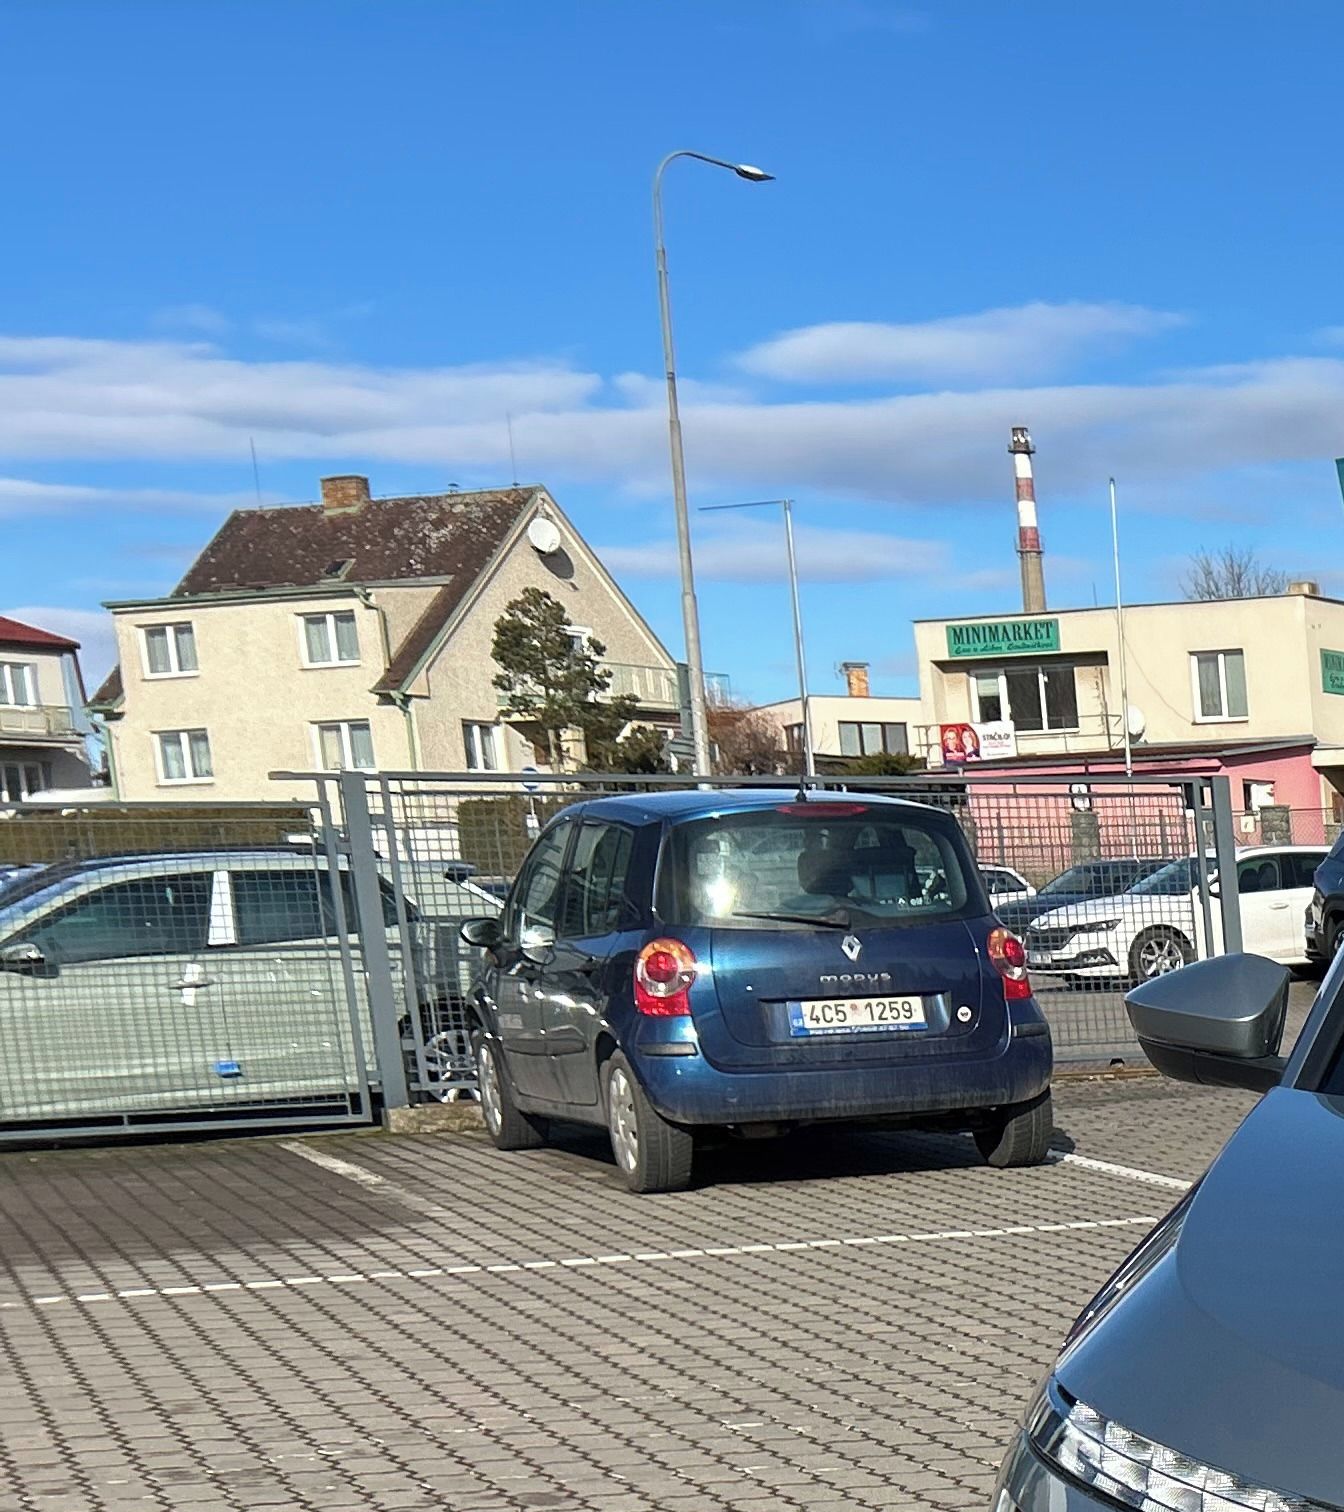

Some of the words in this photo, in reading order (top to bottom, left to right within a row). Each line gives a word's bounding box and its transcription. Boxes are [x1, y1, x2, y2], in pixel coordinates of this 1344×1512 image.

[951, 621, 1053, 645] MINIMARKET
[809, 1003, 848, 1025] 4C5
[864, 1000, 913, 1022] 1259
